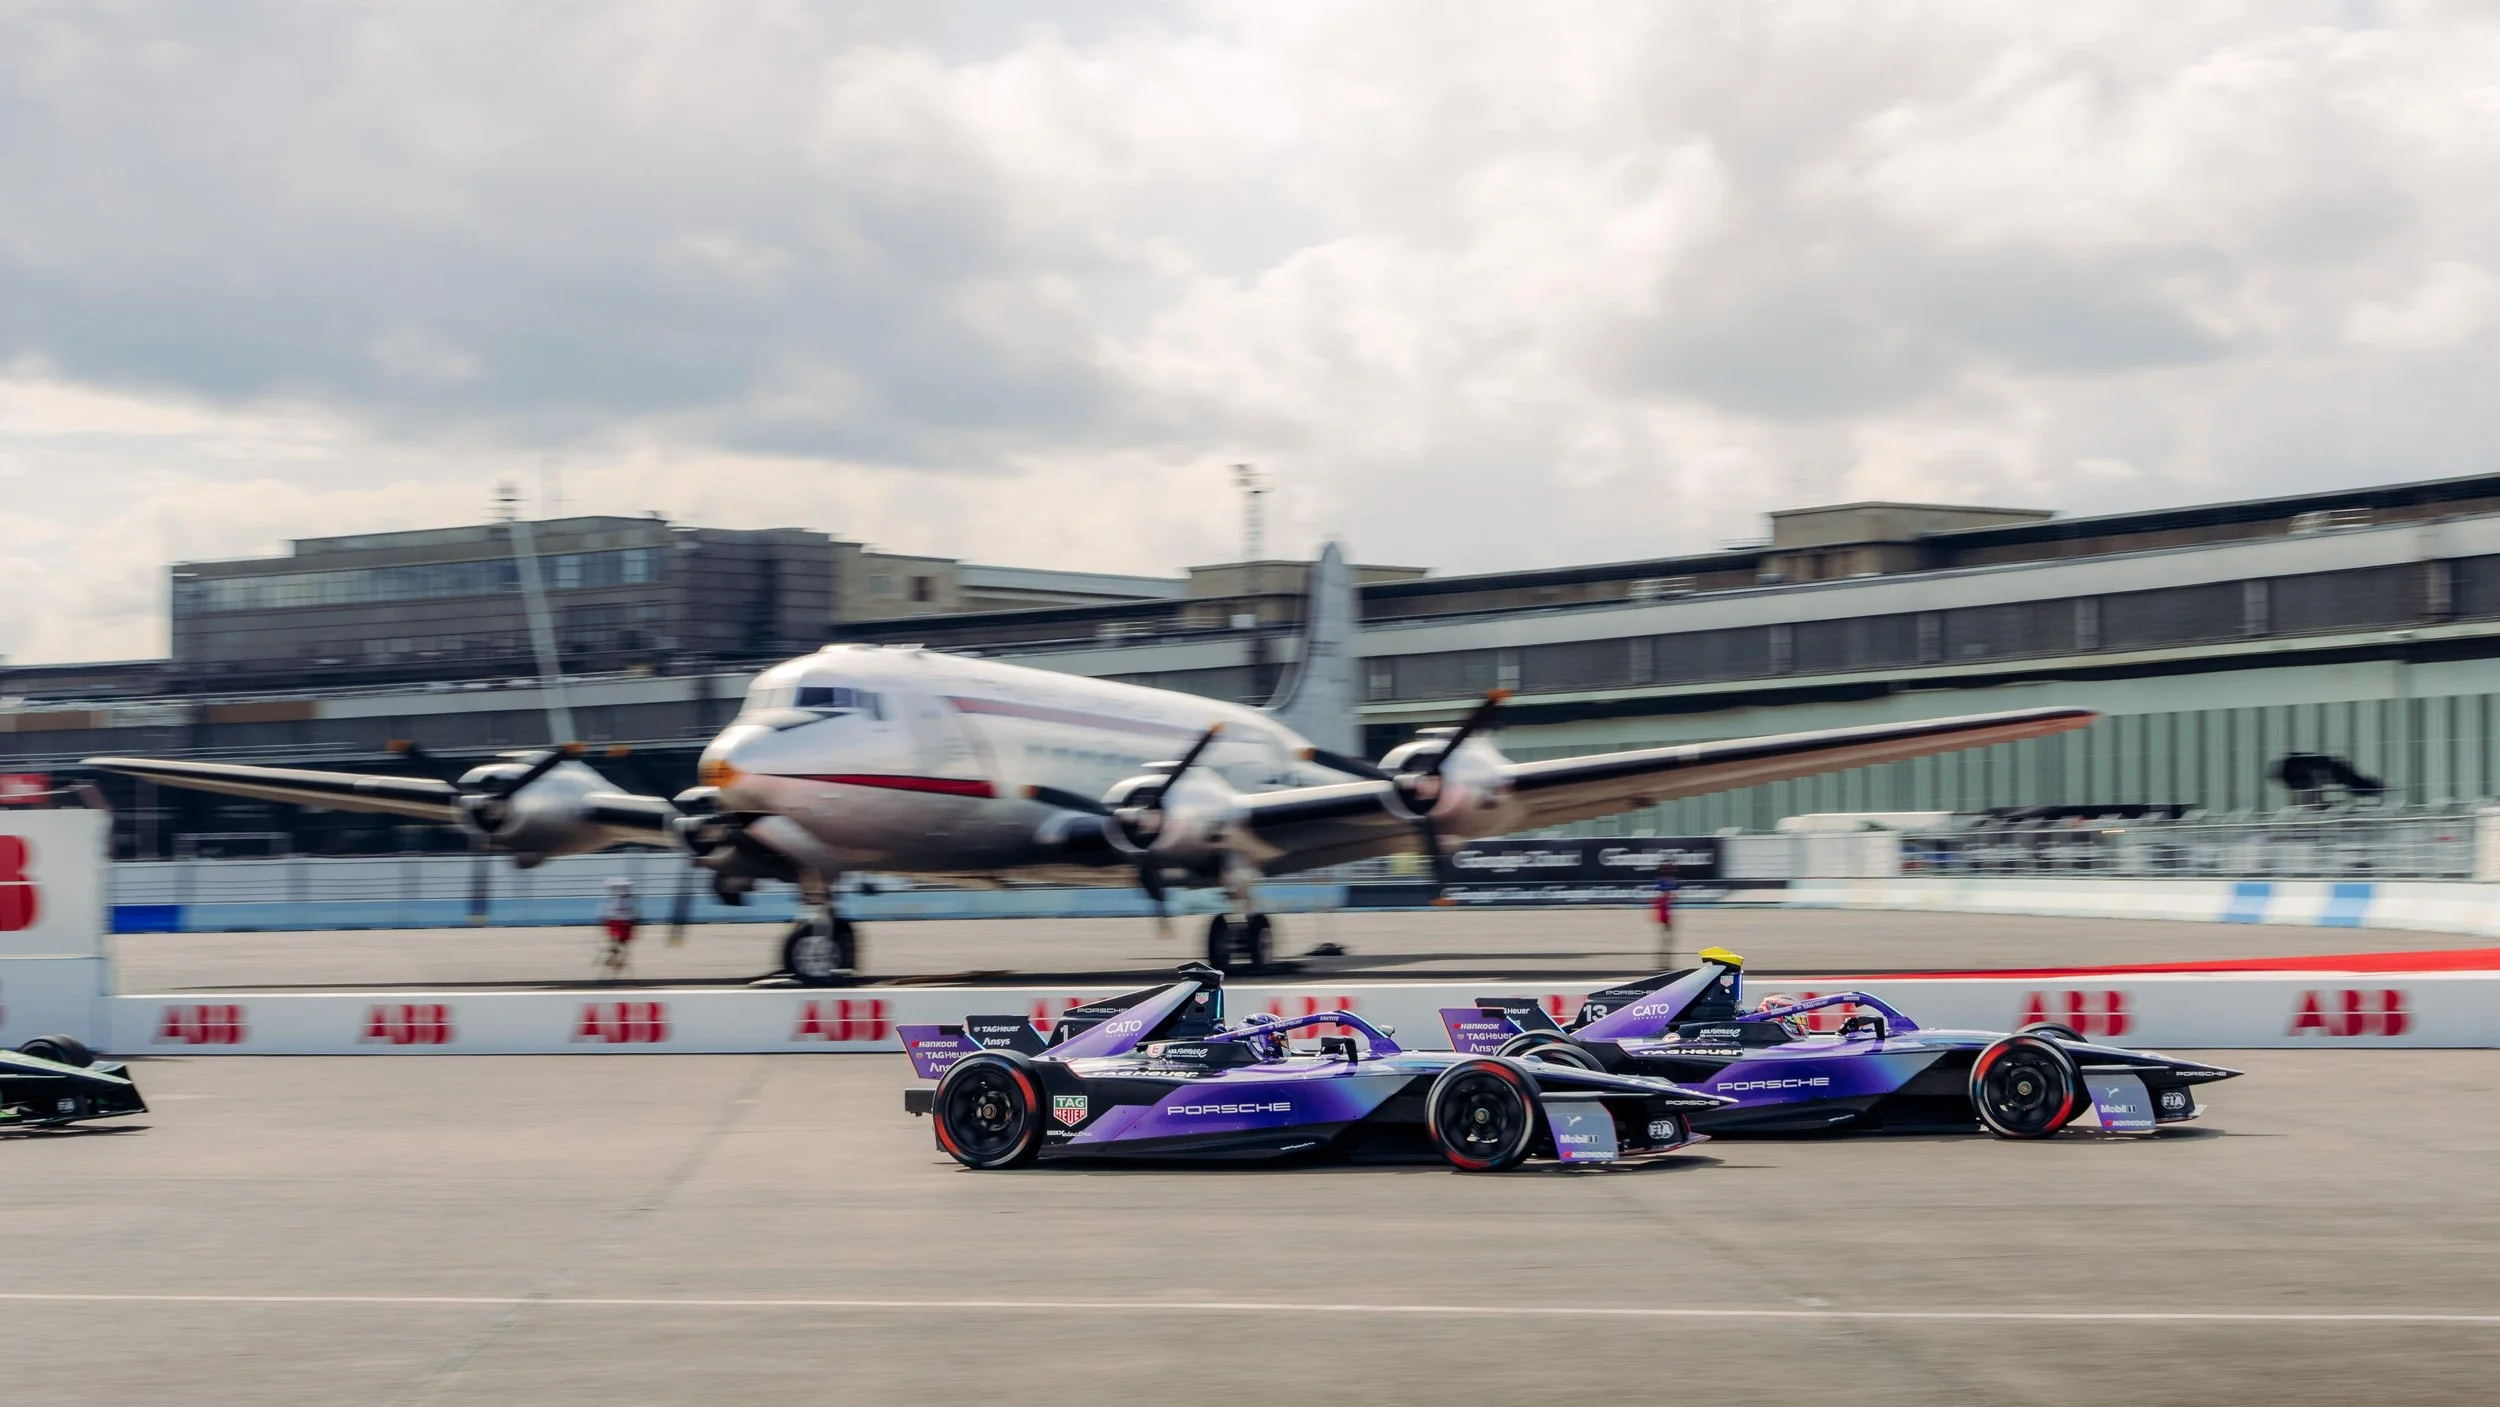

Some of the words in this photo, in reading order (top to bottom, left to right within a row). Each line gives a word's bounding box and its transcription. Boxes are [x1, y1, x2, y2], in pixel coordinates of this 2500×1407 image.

[1583, 1004, 1607, 1022] 13
[1633, 1003, 1669, 1016] CATO
[2013, 990, 2136, 1036] ABB
[2285, 989, 2416, 1036] ABB
[152, 1005, 249, 1044] ABB
[358, 1004, 455, 1044] ABB
[572, 1002, 670, 1043] ABB
[792, 1000, 891, 1041] ABB
[1106, 1020, 1142, 1034] CATO
[1060, 1025, 1069, 1042] 1
[983, 1037, 1011, 1046] Ansys
[930, 1062, 950, 1072] Ans
[1717, 1077, 1830, 1092] PORSCHE
[1056, 1098, 1085, 1108] TAG
[2163, 1095, 2184, 1106] FIA
[1167, 1102, 1291, 1116] PORSCHE
[2101, 1105, 2127, 1113] Mobil
[1055, 1109, 1086, 1125] HEUER
[1649, 1124, 1671, 1135] FIA
[1560, 1135, 1588, 1144] Mobil
